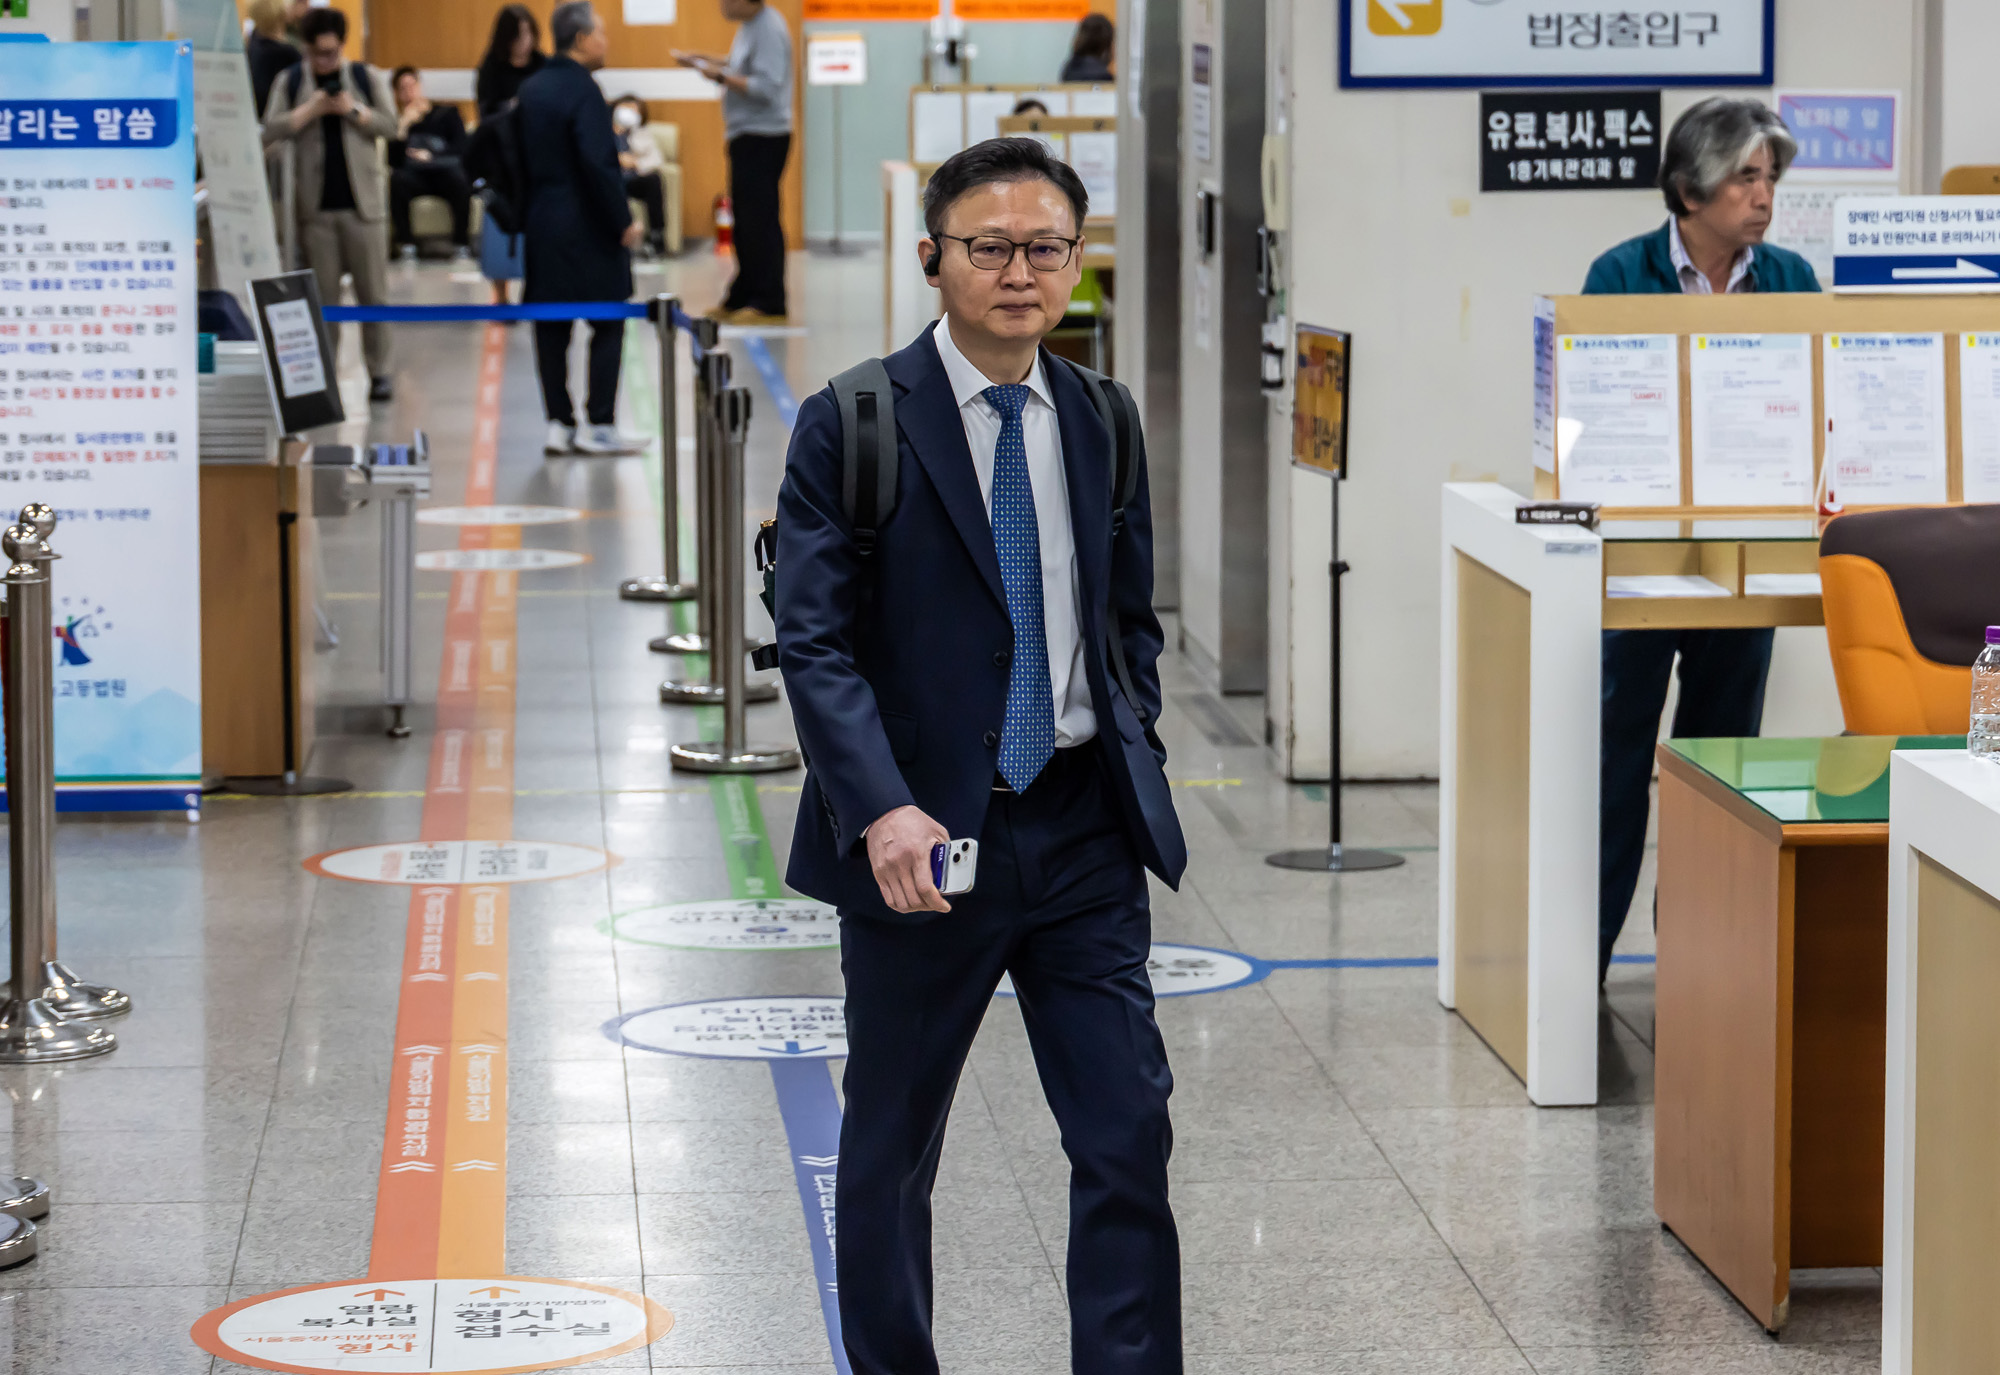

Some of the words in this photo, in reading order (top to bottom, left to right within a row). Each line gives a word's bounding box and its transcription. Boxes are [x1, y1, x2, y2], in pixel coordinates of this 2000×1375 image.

[1528, 12, 1718, 49] 법정출입구
[93, 107, 156, 141] 말씀
[1488, 109, 1653, 151] 유료.복사.팩스
[1848, 210, 1879, 224] 장애인
[1883, 210, 1926, 223] 사법지원
[1929, 209, 1971, 223] 신청서가
[1848, 231, 1880, 245] 접수실
[1883, 231, 1937, 245] 민원안내로
[1942, 230, 1995, 244] 문의하시기
[53, 679, 127, 698] 고등법원
[338, 1304, 418, 1316] 열람
[456, 1300, 607, 1309] 서울중앙지방법원
[298, 1316, 417, 1328] 복사실
[453, 1308, 561, 1323] 형사
[454, 1322, 613, 1338] 접수실
[243, 1333, 417, 1343] 서울중앙지방법원
[336, 1343, 418, 1354] 형사
